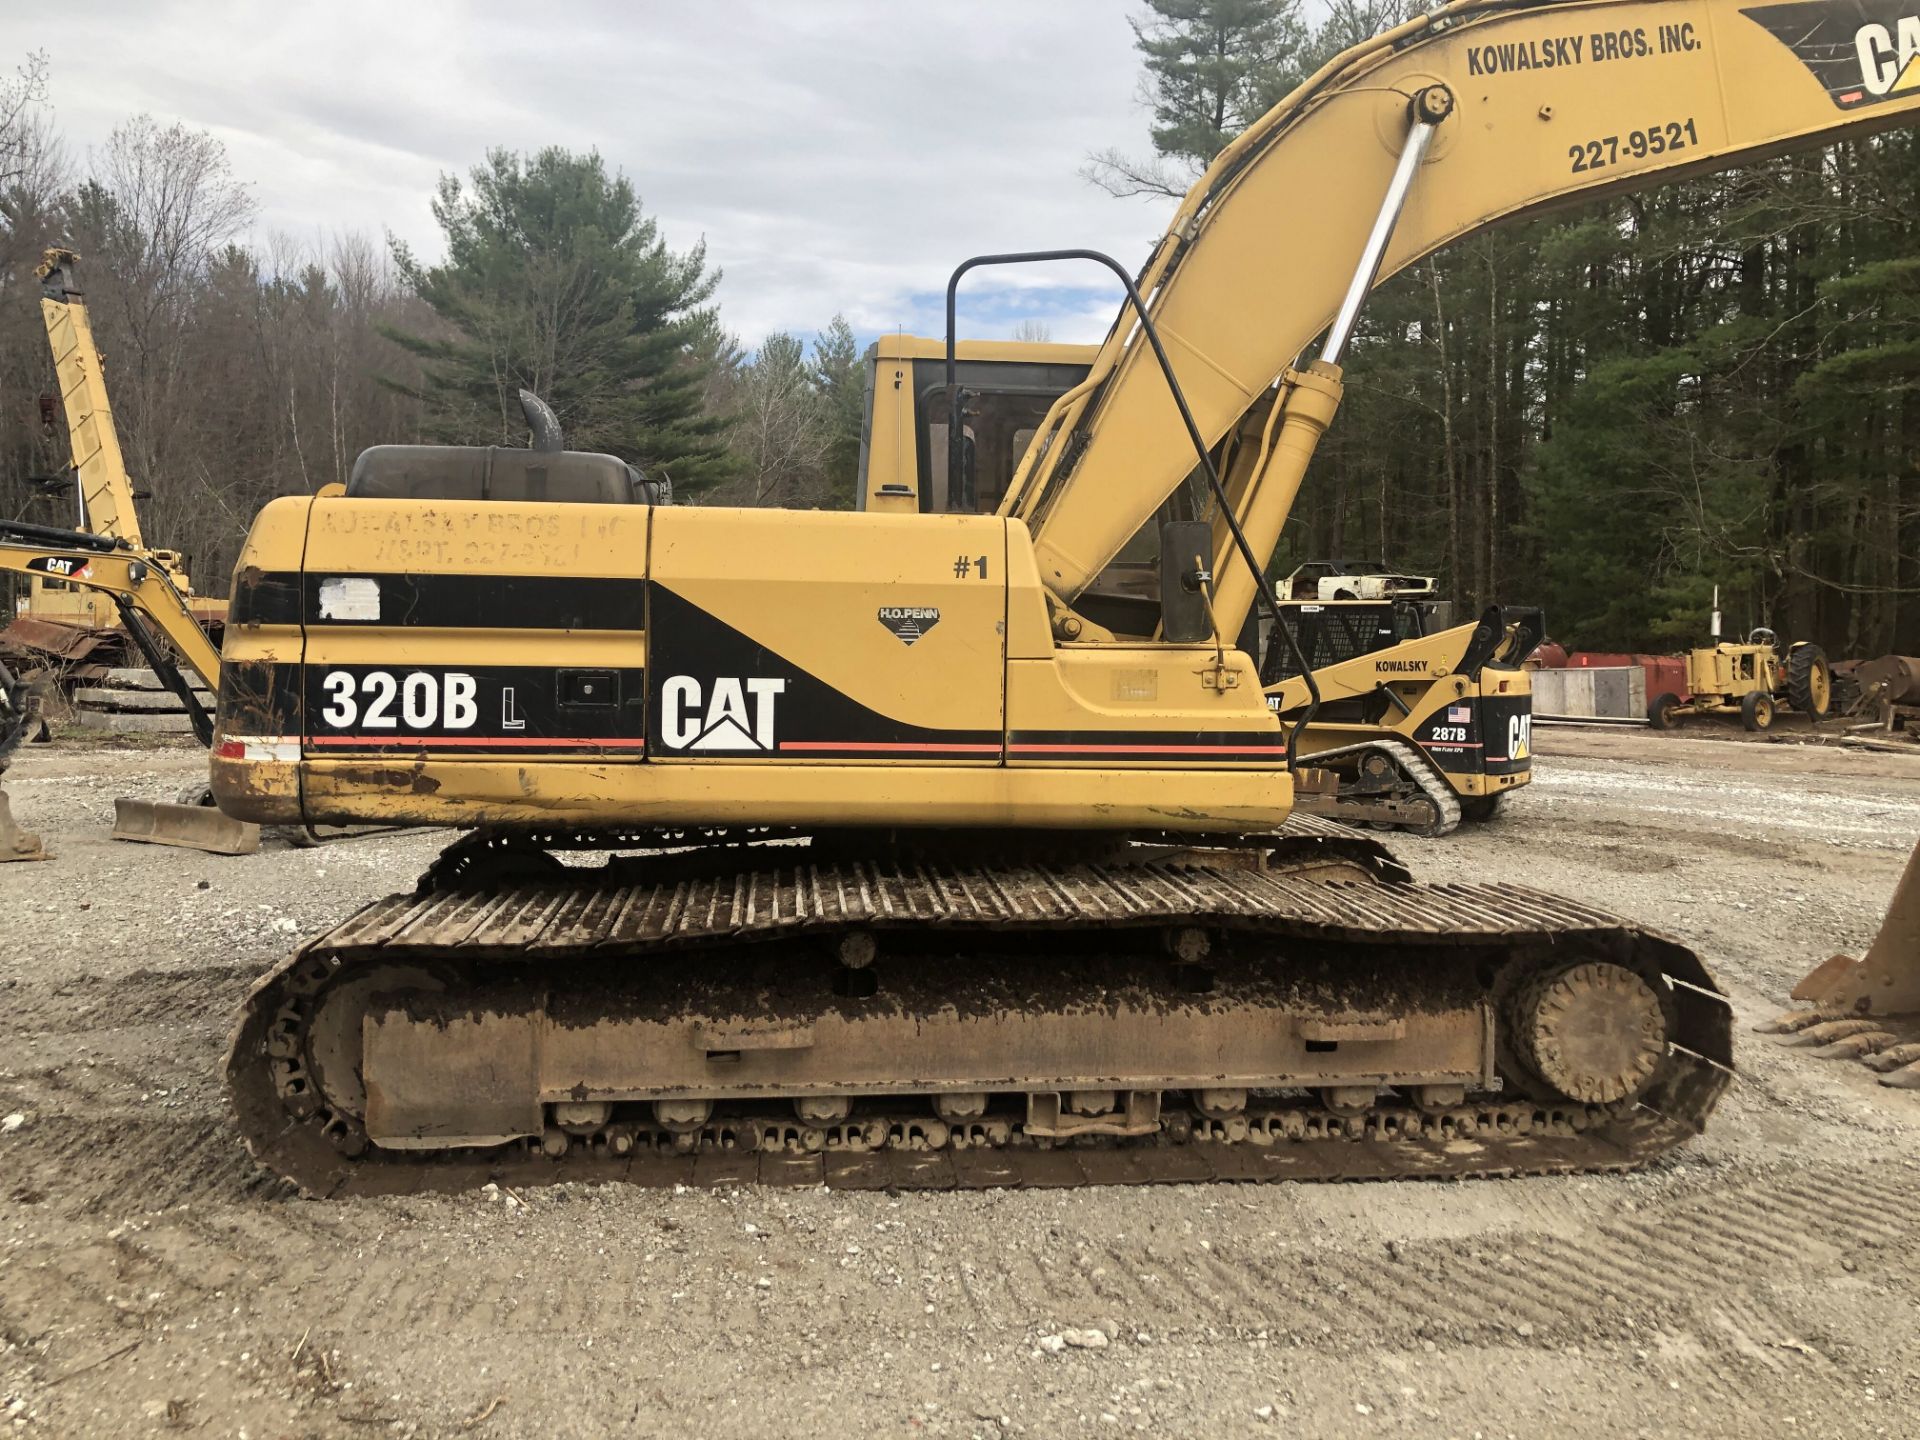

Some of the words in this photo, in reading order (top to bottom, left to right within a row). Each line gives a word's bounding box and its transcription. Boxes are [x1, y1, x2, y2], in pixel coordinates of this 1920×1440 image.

[1467, 36, 1583, 76] KOWALSKY
[1590, 28, 1653, 62] BROS.
[1659, 22, 1702, 54] INC.
[1568, 118, 1699, 173] 227-9521
[46, 558, 73, 575] CAT
[953, 555, 987, 579] #1
[1375, 660, 1428, 673] KOWALSKY
[322, 671, 478, 729] 320B
[502, 687, 526, 729] L
[662, 675, 786, 751] CAT
[1431, 726, 1467, 741] 287B
[1508, 713, 1532, 760] CAT
